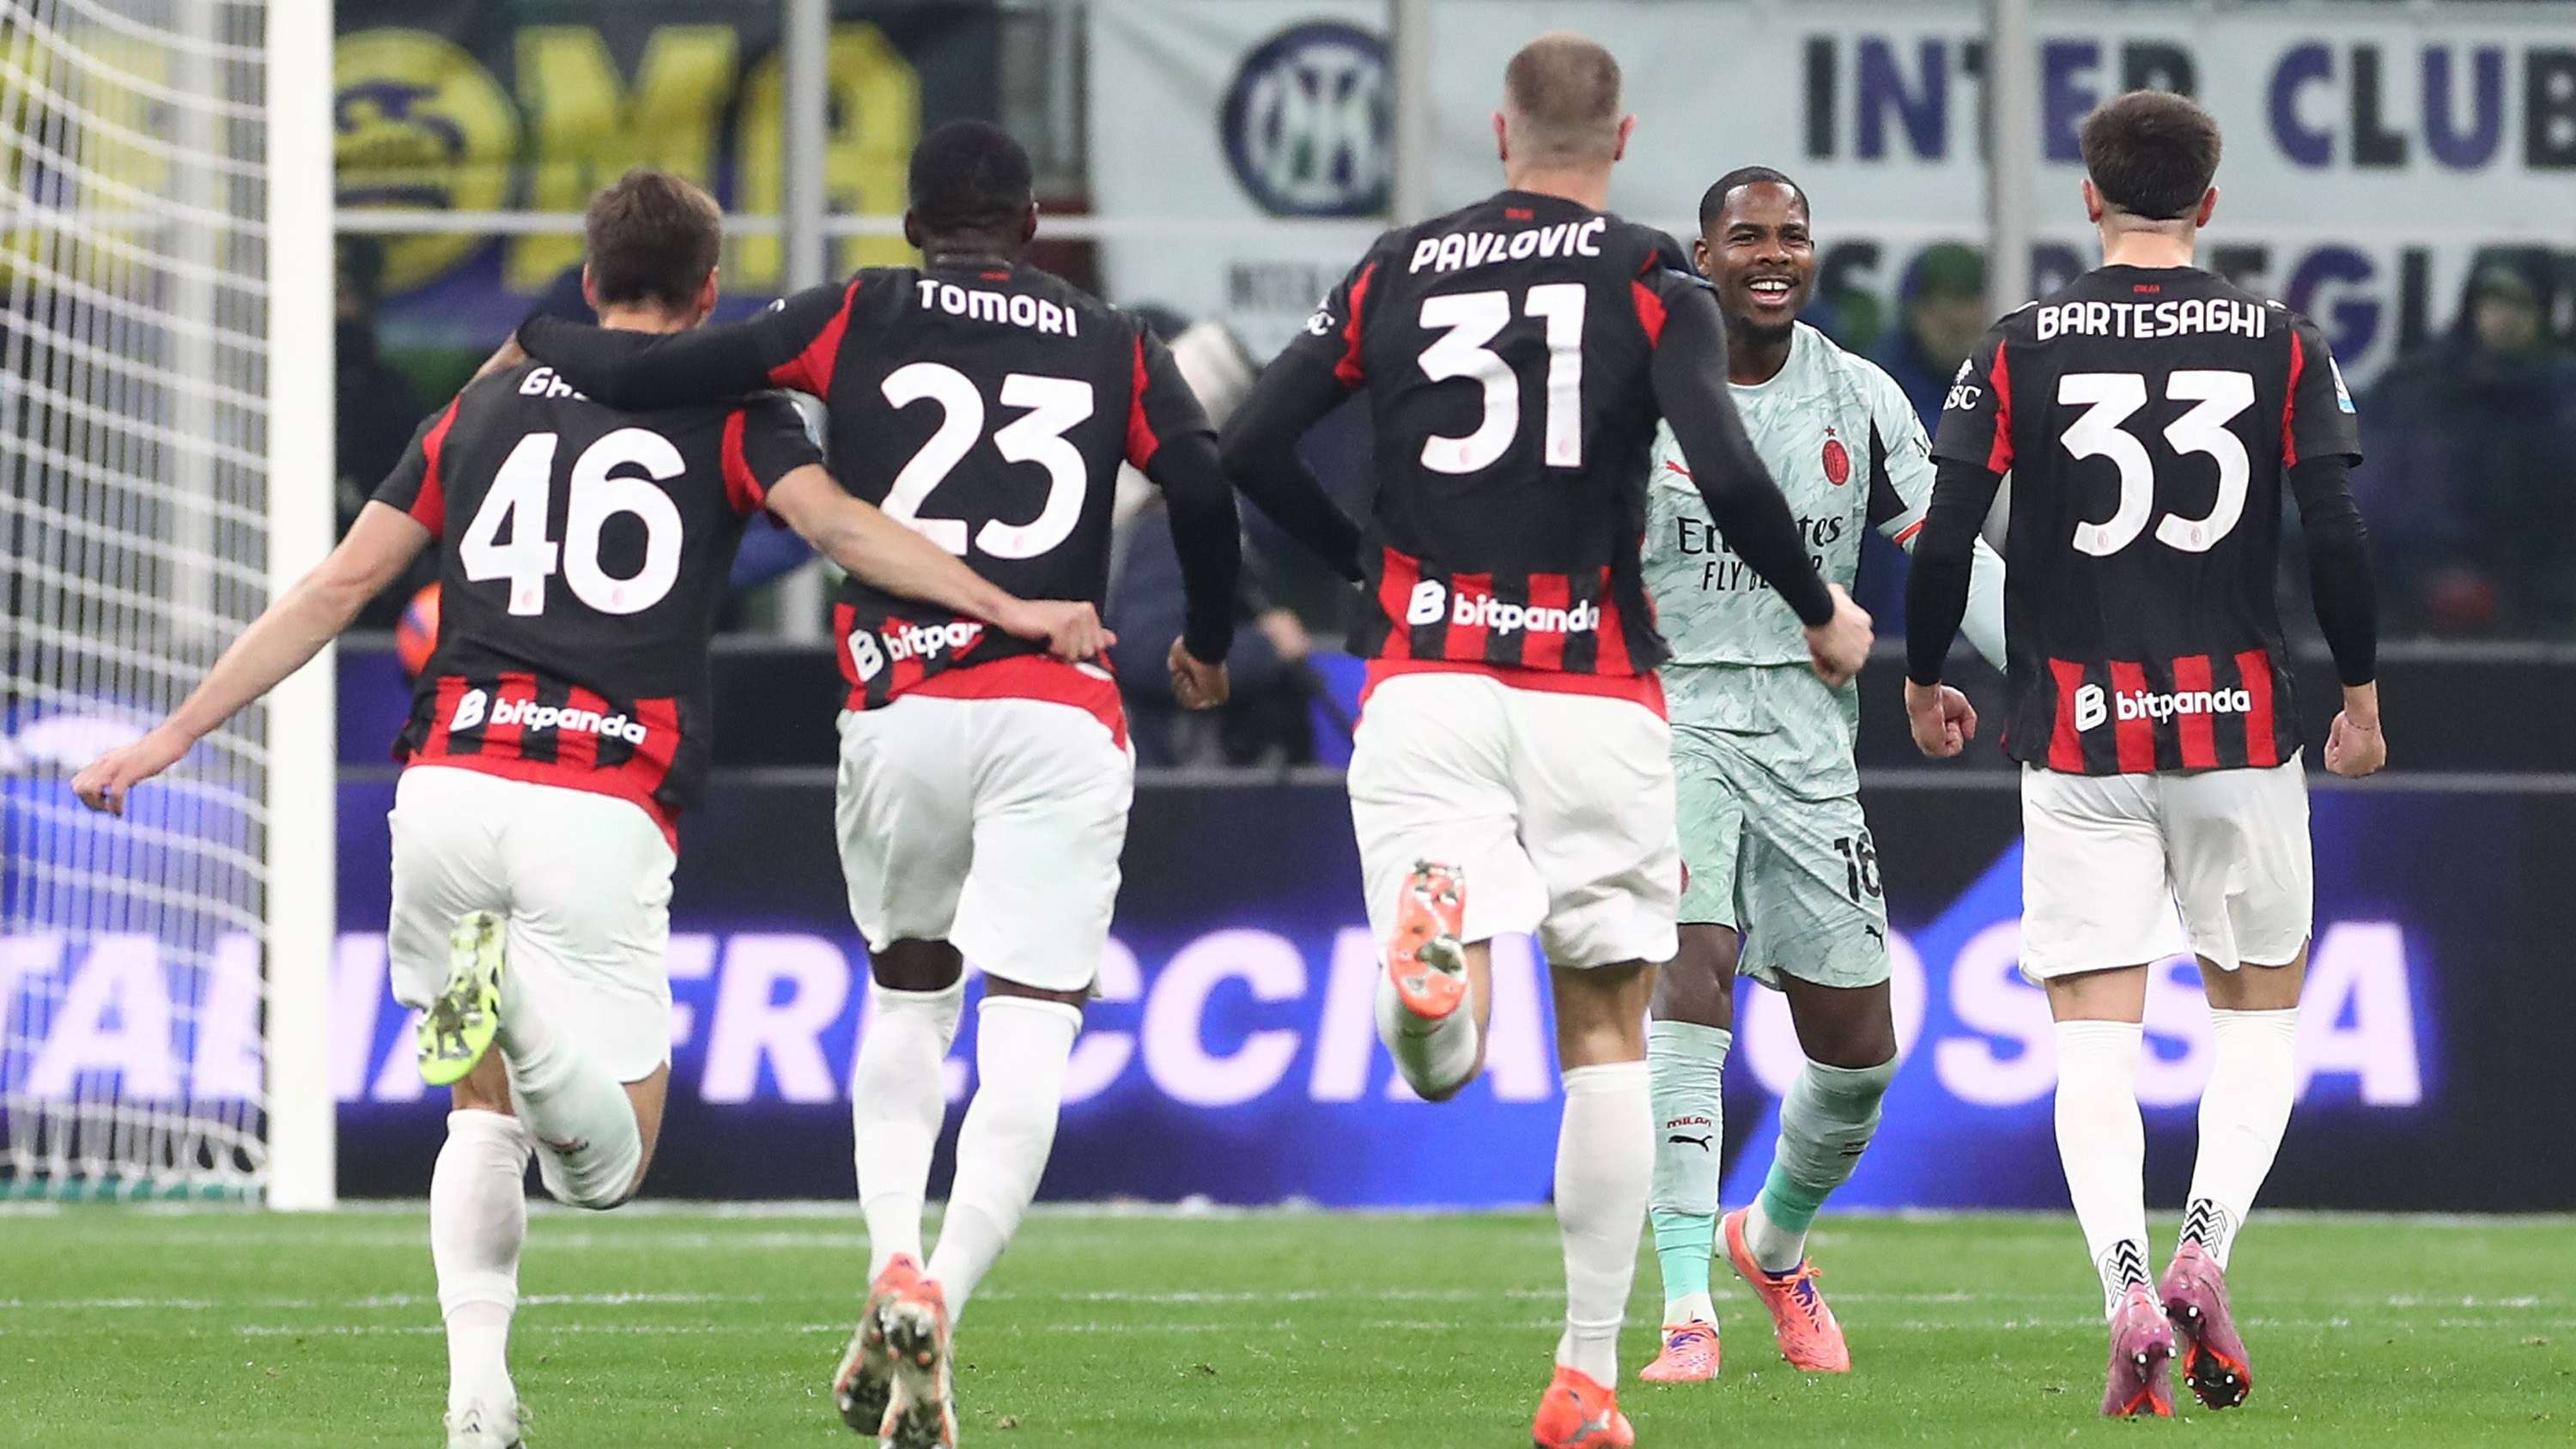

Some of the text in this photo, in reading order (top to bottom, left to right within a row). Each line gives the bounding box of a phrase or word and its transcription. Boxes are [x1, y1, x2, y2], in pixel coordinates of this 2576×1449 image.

[1806, 37, 2576, 173] INE CLUB
[915, 279, 1078, 338] TOMORI
[2037, 299, 2266, 342] BARTESAGHI
[1418, 282, 1587, 474] 31
[879, 361, 1095, 560] 23
[2057, 369, 2257, 557] 33
[458, 427, 687, 617] 46
[1703, 560, 1744, 591] FLY
[1452, 592, 1601, 636] bitpanda
[489, 697, 648, 745] bitpanda
[2115, 687, 2251, 724] bitpanda
[1833, 831, 1882, 903] 16
